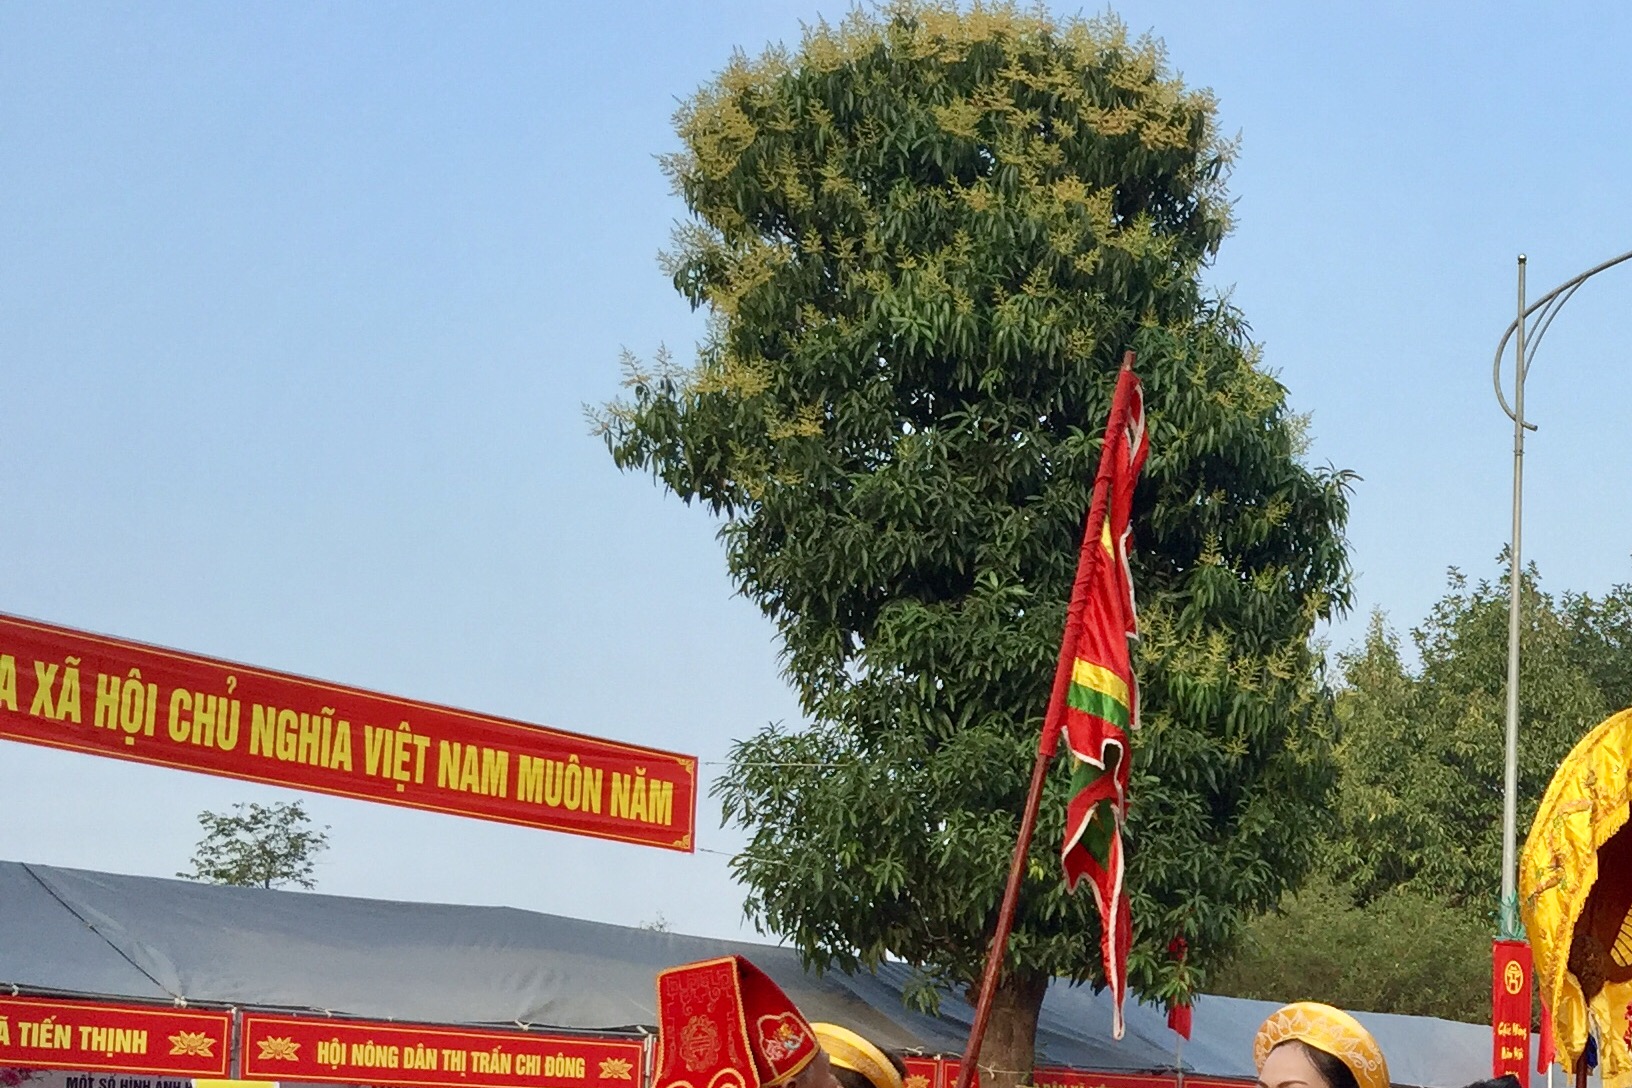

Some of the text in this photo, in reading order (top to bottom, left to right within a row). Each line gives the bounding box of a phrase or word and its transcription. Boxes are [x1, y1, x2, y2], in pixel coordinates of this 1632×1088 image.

[30, 656, 82, 723] XÃ
[94, 668, 157, 745] HỘI
[168, 675, 240, 750] CHỦ
[250, 706, 353, 772] NGHĨA
[364, 722, 431, 792] VIỆT
[437, 740, 508, 798] NAM
[517, 754, 602, 815] MUÔN
[610, 763, 673, 826] NĂM
[18, 1015, 72, 1050] TIẾN
[79, 1026, 147, 1057] THỊNH
[317, 1039, 586, 1079] HỘI NÔNG DÂN THỊ TRẤN CHI ĐÔNG
